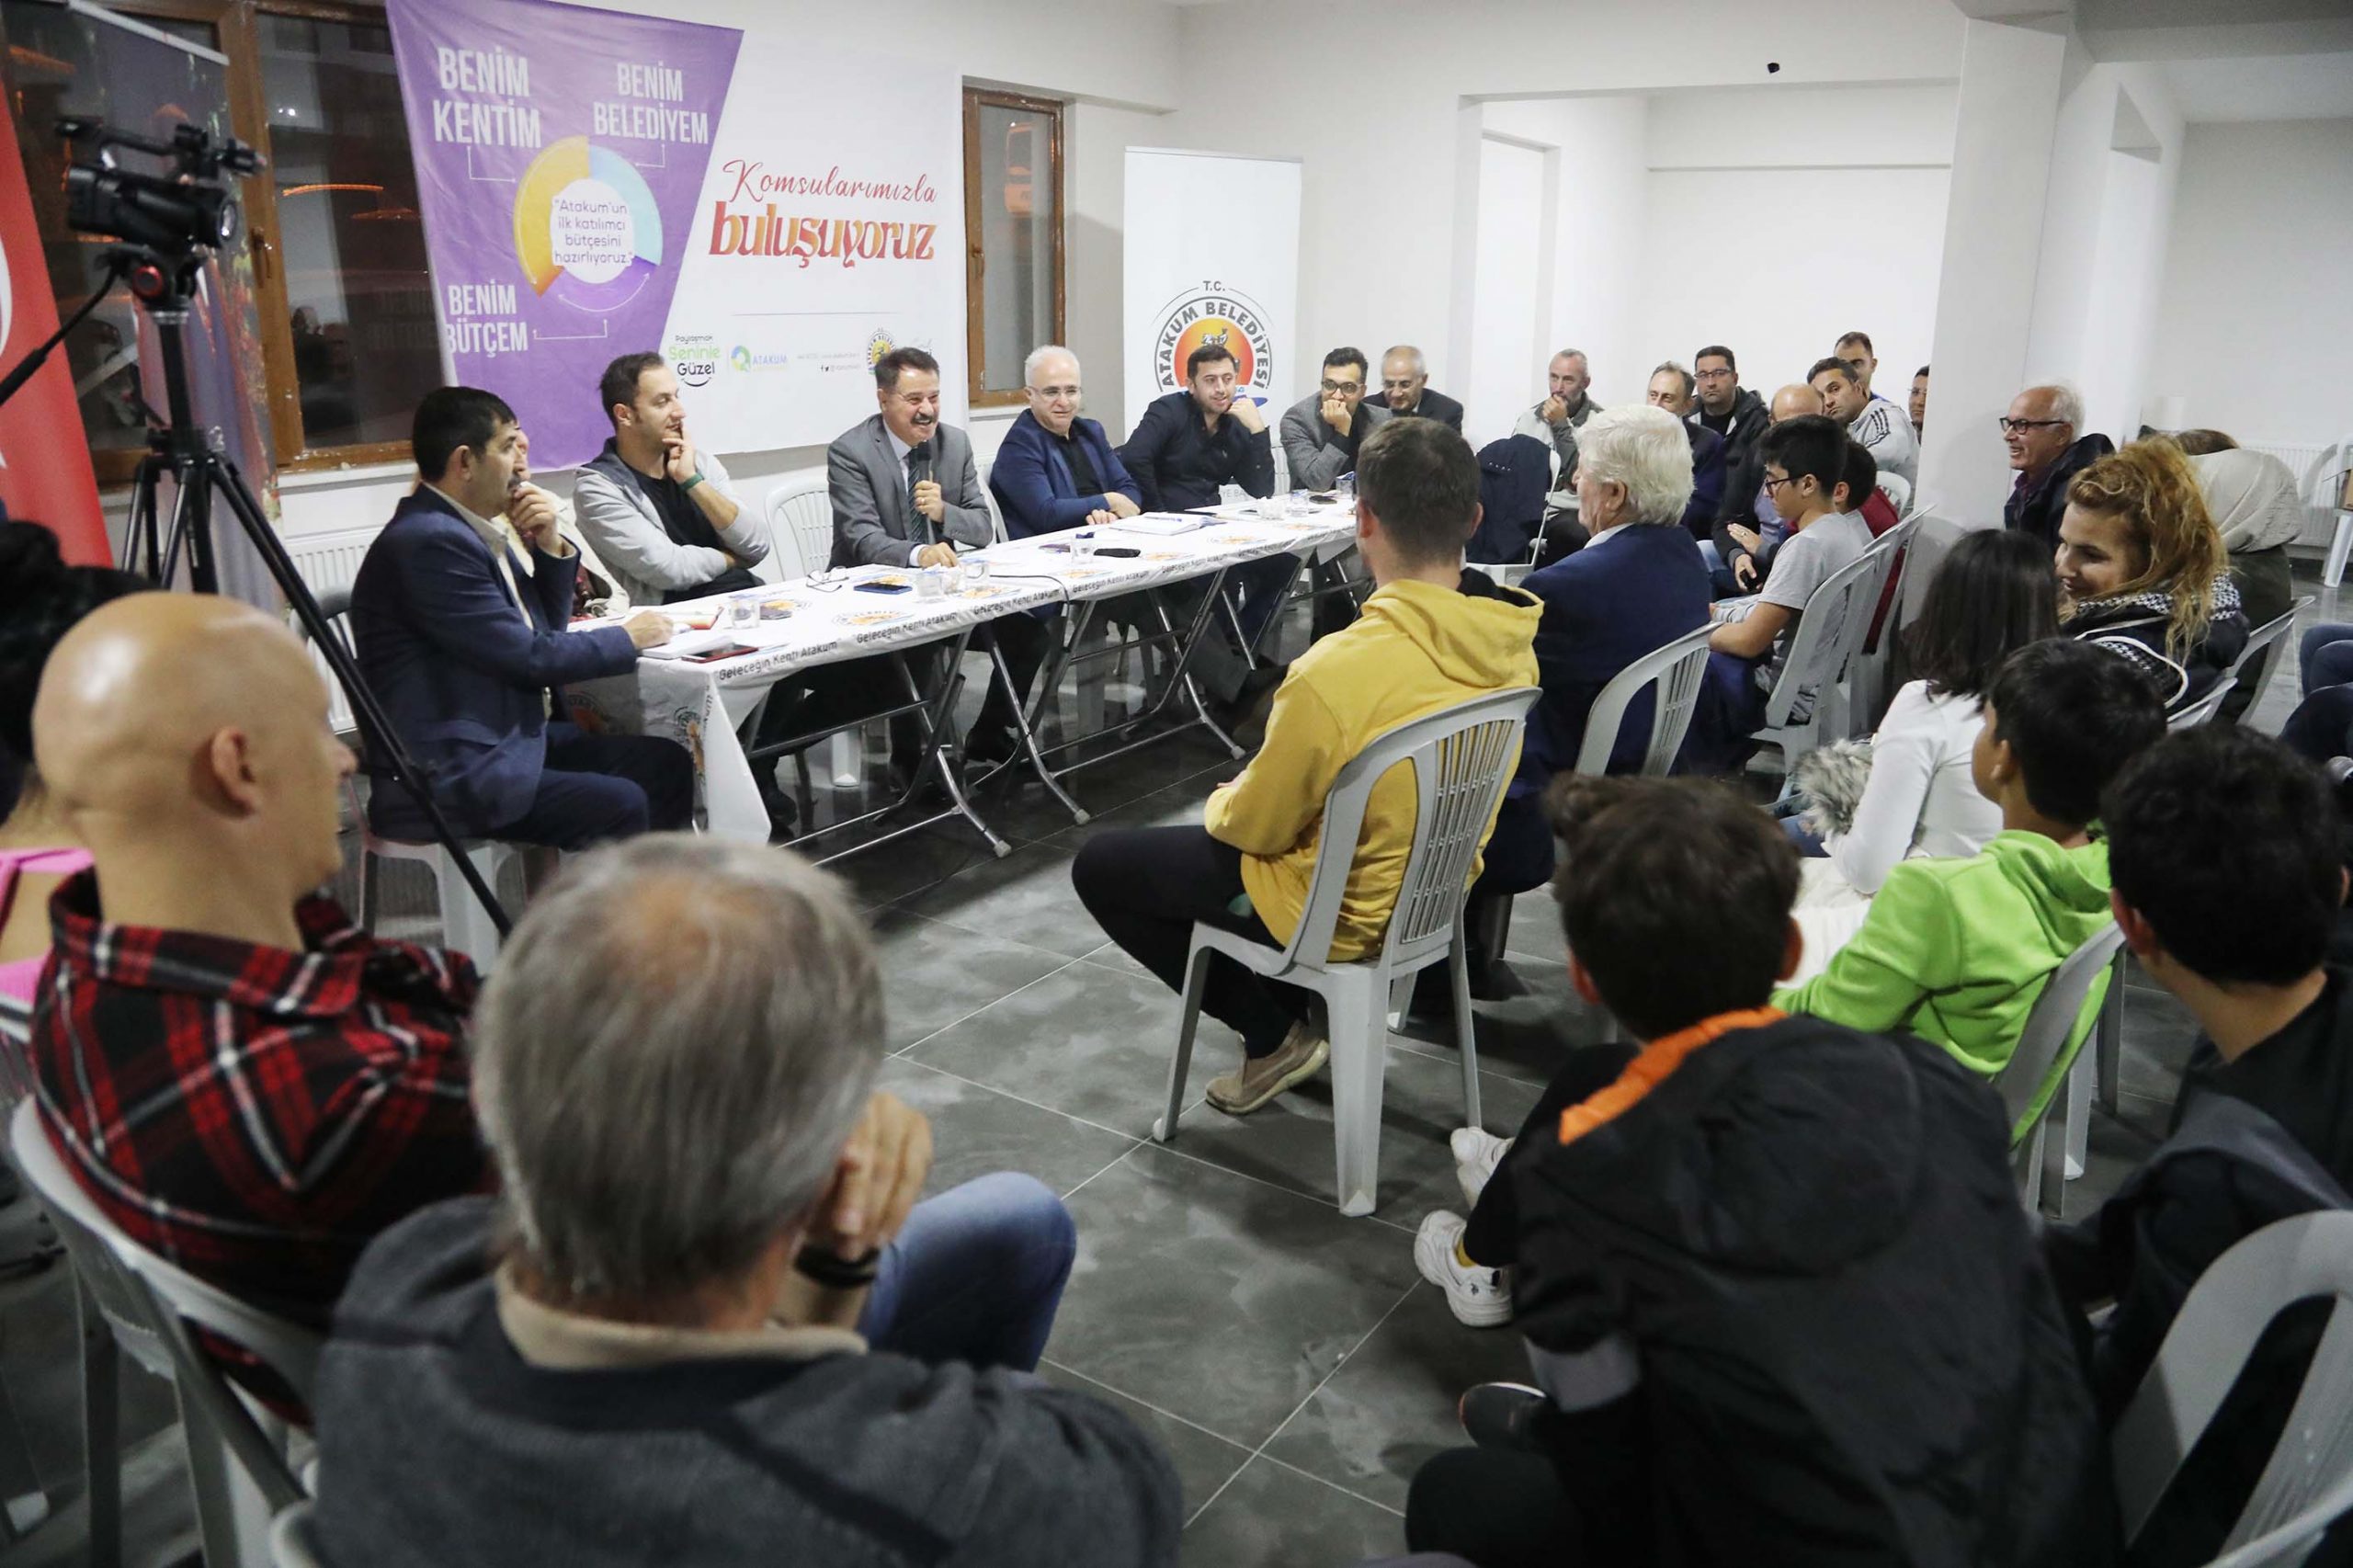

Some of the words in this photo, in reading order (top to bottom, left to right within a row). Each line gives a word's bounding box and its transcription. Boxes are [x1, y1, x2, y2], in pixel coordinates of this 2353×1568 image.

[438, 45, 530, 97] BENİM
[617, 60, 683, 103] BENİM
[432, 97, 541, 149] KENTİM
[593, 102, 709, 144] BELEDİYEM
[558, 216, 572, 229] ilk
[574, 216, 625, 231] katılımcı
[565, 233, 621, 250] bütçesini
[709, 200, 938, 268] buluşuyoruz
[448, 278, 517, 315] BENİM
[1202, 280, 1226, 291] T.C.
[445, 317, 529, 358] BÜTÇEM
[668, 346, 721, 360] Seninle
[1159, 306, 1199, 386] ATAKUM
[1205, 301, 1269, 390] BELEDİYESİ
[676, 361, 715, 376] Güzel
